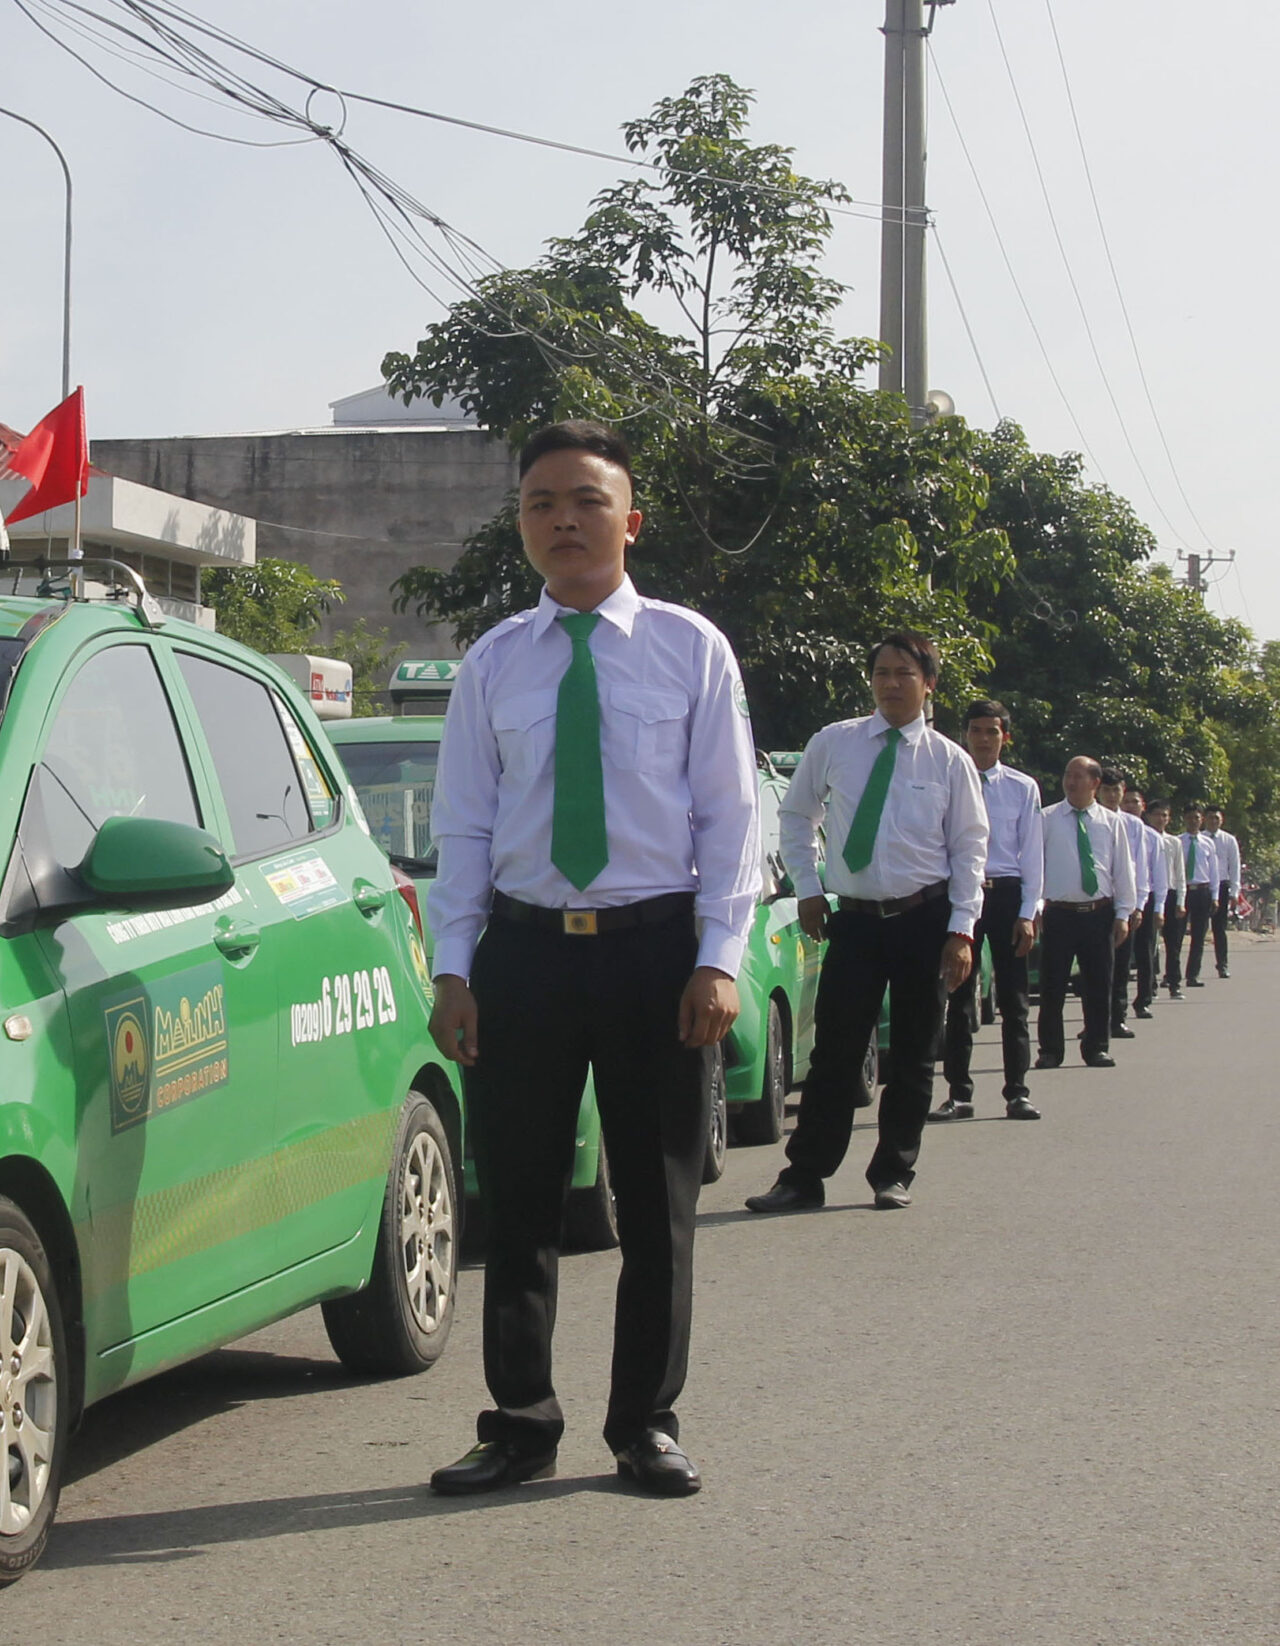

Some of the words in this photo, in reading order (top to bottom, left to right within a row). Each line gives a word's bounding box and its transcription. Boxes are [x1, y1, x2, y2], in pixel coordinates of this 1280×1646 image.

[772, 754, 804, 765] TA
[334, 974, 352, 1036] 29
[353, 969, 374, 1030] 29
[373, 966, 397, 1025] 29
[157, 1058, 227, 1108] CORPORATION
